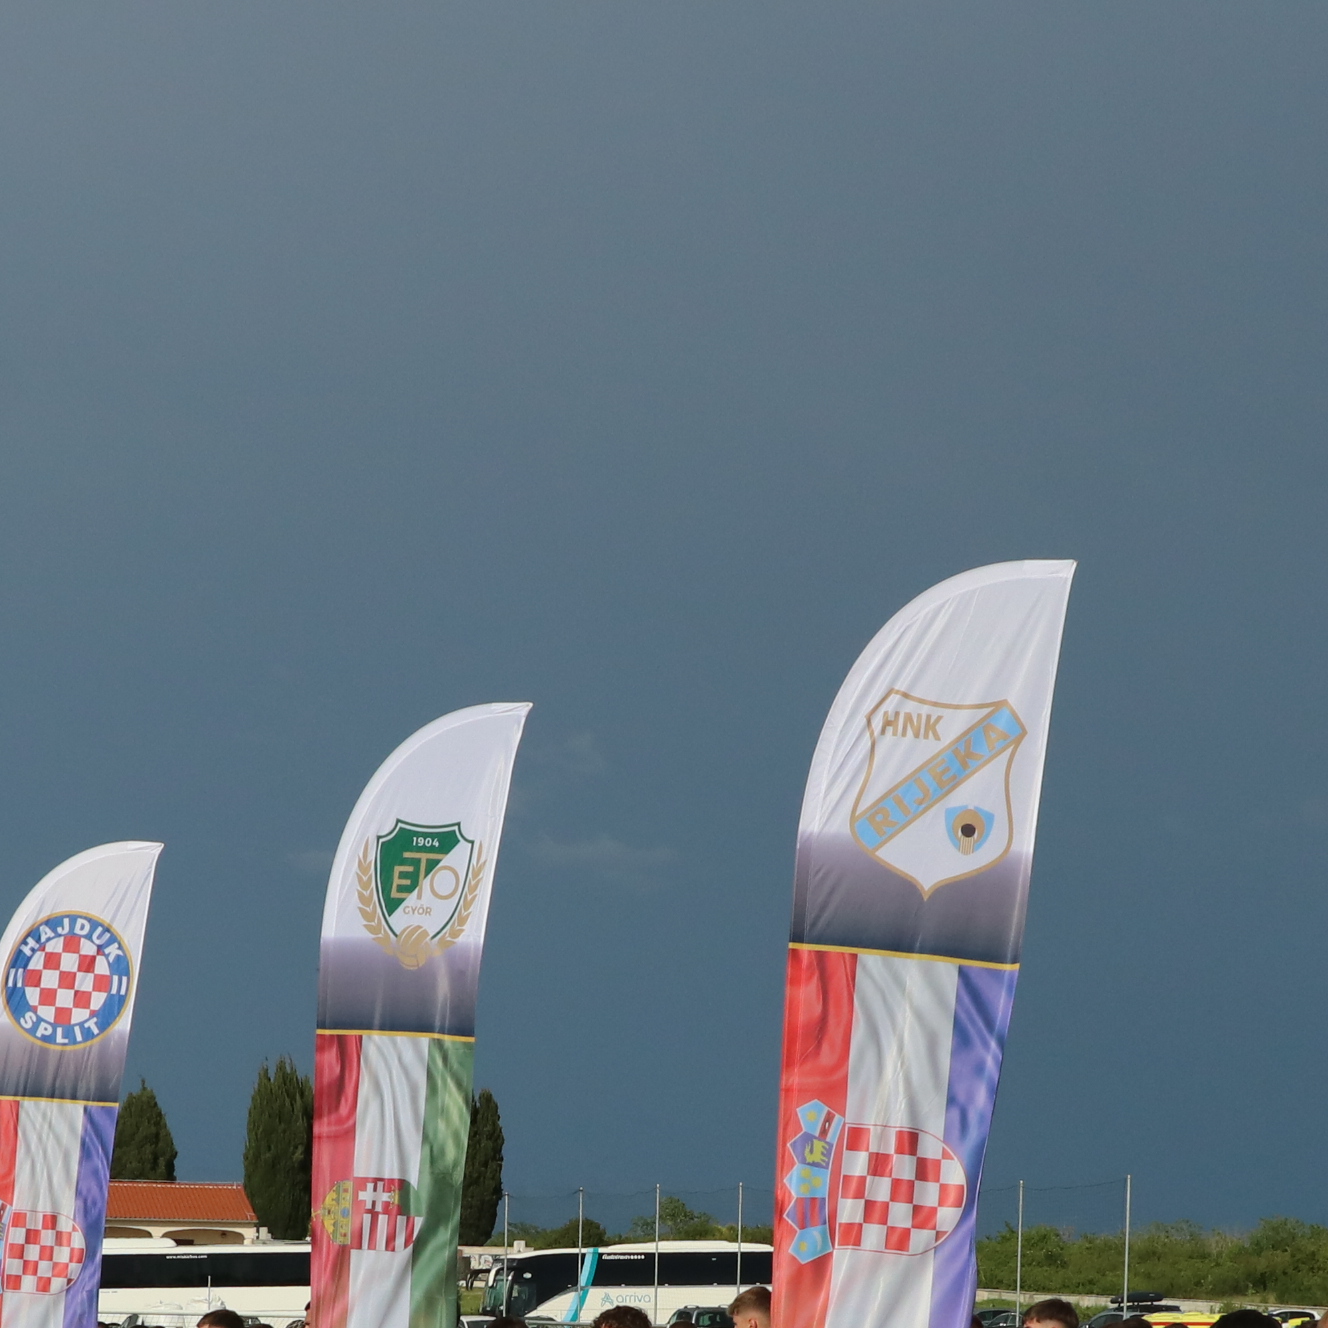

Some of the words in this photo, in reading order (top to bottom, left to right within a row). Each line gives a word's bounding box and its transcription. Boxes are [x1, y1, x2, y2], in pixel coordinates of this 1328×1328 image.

[880, 710, 944, 742] HNK
[867, 721, 1011, 838] RIJEKA
[412, 836, 440, 848] 1904
[390, 851, 461, 901] ETO
[402, 904, 432, 916] GYŐR
[19, 917, 124, 964] HAJDUK
[19, 1011, 100, 1044] SPLIT
[615, 1291, 652, 1304] arriva
